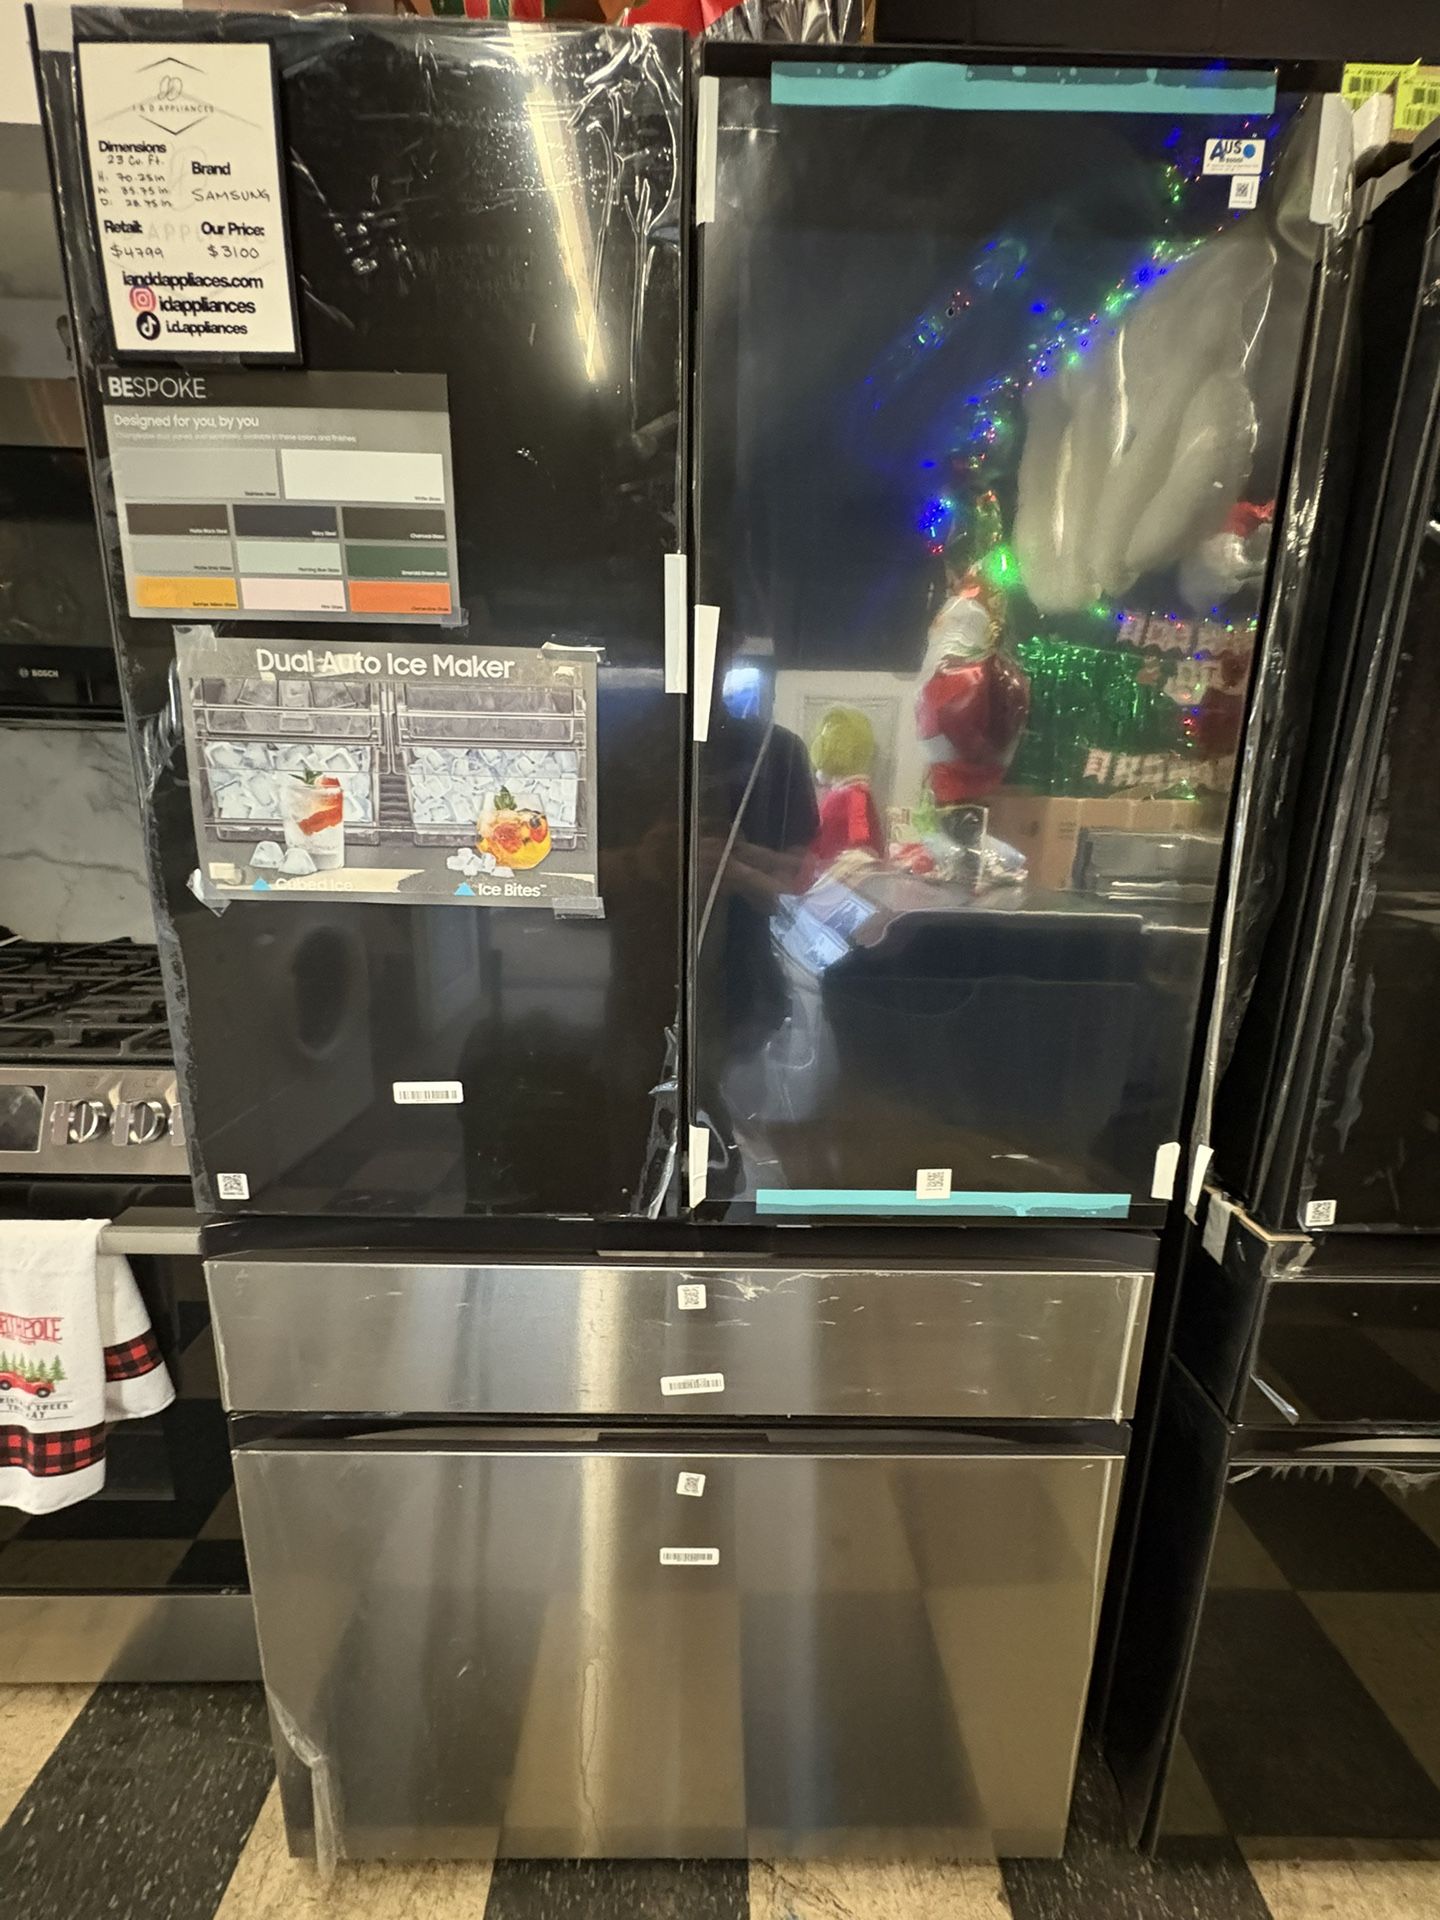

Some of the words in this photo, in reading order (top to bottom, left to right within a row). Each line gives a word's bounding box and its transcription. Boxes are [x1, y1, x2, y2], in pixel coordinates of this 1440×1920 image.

[98, 139, 168, 153] Dimensions
[107, 154, 124, 165] 23
[191, 160, 232, 176] Brand
[191, 188, 271, 203] SAMSUNG
[201, 221, 226, 235] Our
[228, 222, 265, 237] Price:
[206, 244, 260, 259] $3100
[107, 375, 207, 399] BESPOKE
[114, 413, 171, 430] Designed
[173, 413, 191, 428] for
[218, 414, 235, 431] by
[236, 416, 260, 431] you
[256, 648, 315, 673] Dual
[321, 651, 382, 675] Auto
[387, 652, 427, 675] Ice
[432, 653, 516, 679] Maker
[31, 669, 59, 678] BOSCH
[478, 883, 502, 896] Ice
